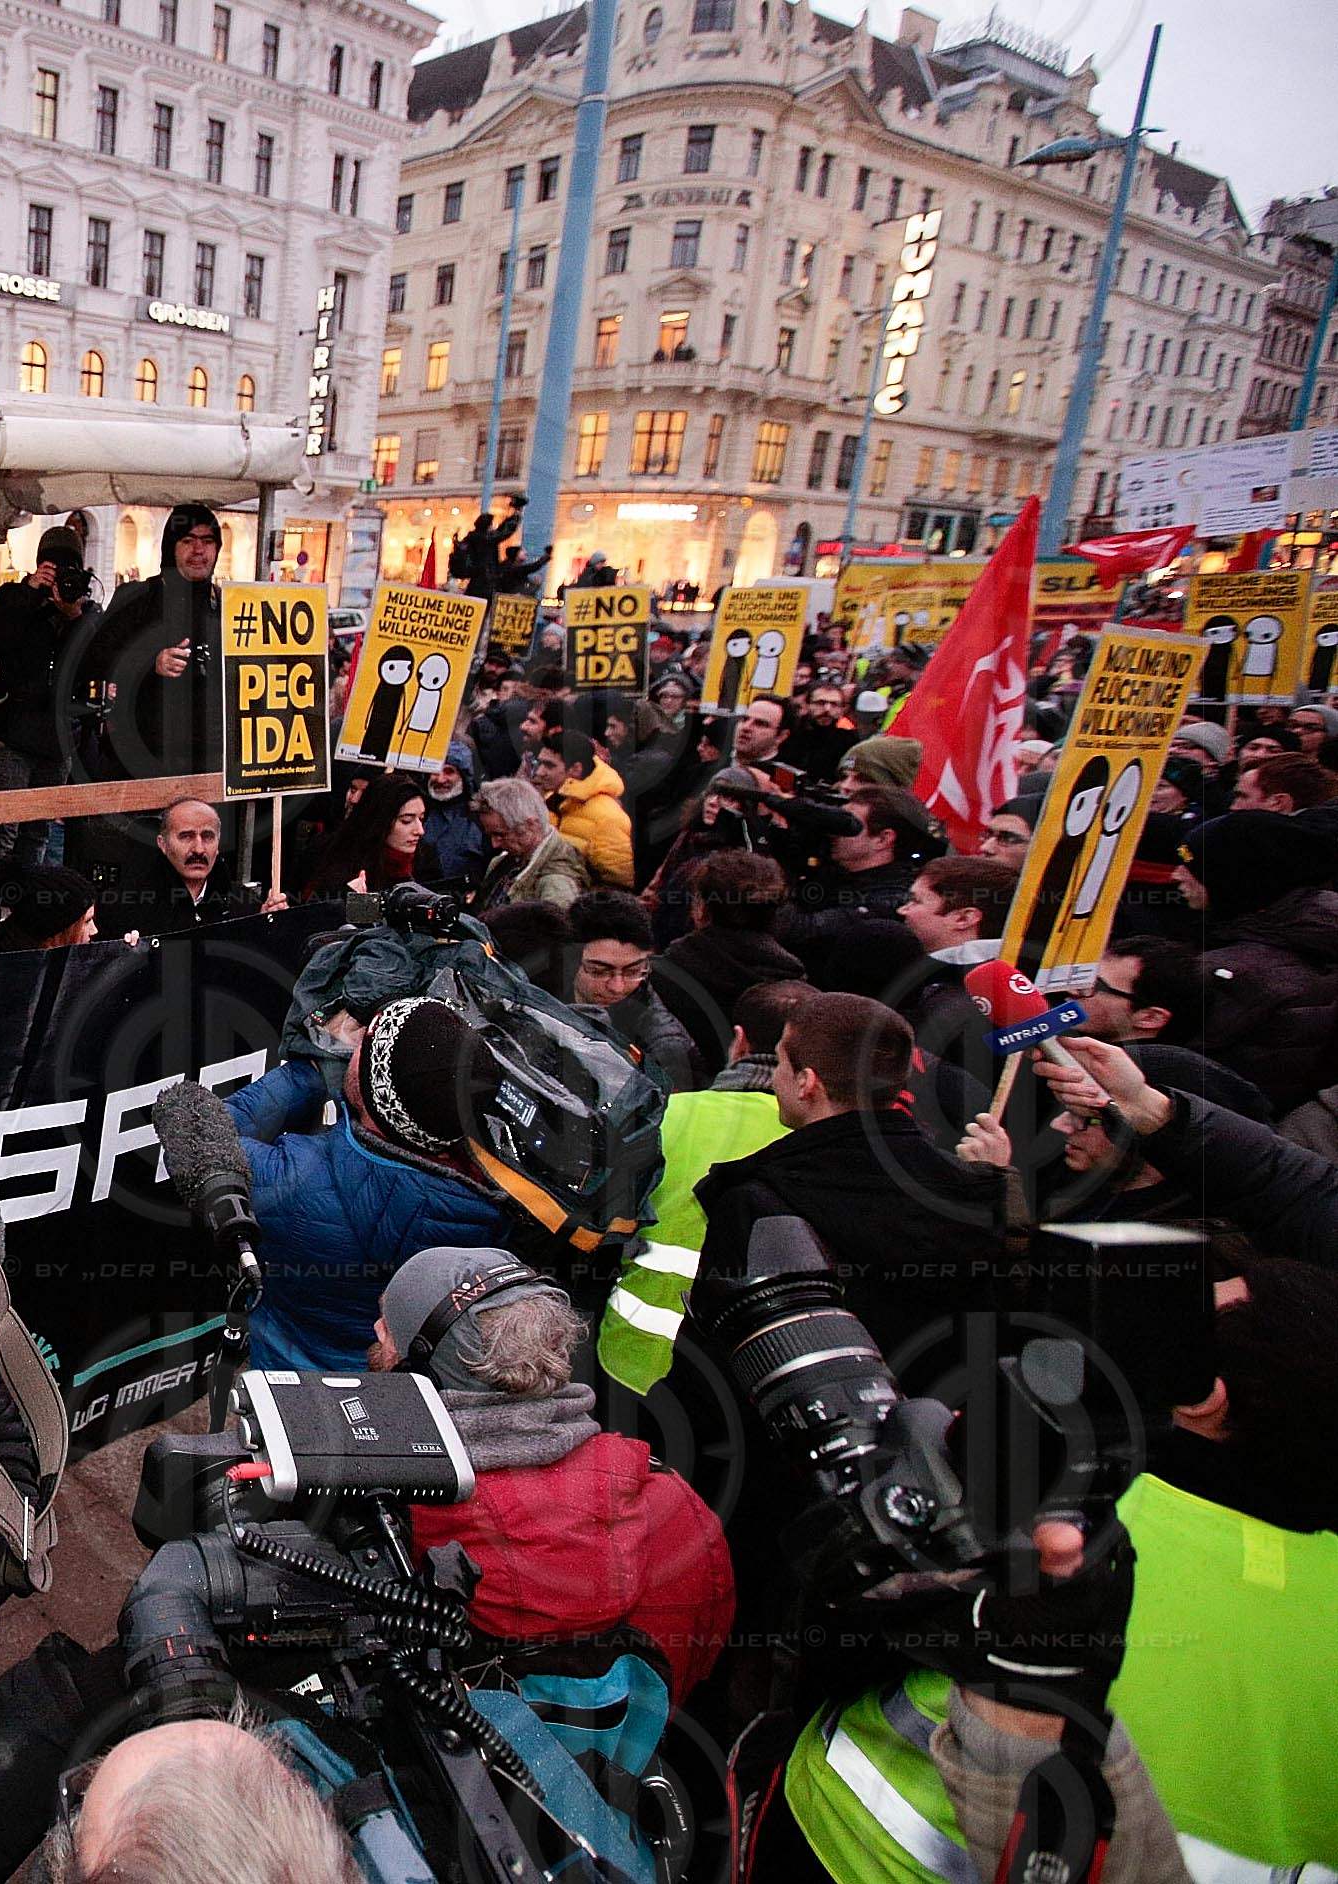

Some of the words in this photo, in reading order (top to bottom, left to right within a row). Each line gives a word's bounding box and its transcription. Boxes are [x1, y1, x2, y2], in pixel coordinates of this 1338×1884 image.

[148, 301, 230, 332] GRÖSSEN
[873, 209, 943, 415] HUMANIC
[306, 286, 336, 456] HIRMER
[387, 590, 445, 613] MUSLIME
[446, 601, 474, 618] UND
[574, 594, 638, 621] #NO
[233, 600, 315, 648] #NO
[378, 619, 471, 647] WILLKOMMEN!
[575, 627, 638, 653] PEG
[575, 655, 636, 681] IDA
[239, 662, 315, 711] PEG
[240, 714, 314, 765] IDA
[998, 1023, 1049, 1046] HITRAD
[114, 1361, 198, 1408] IMMER
[351, 1427, 377, 1435] LITE
